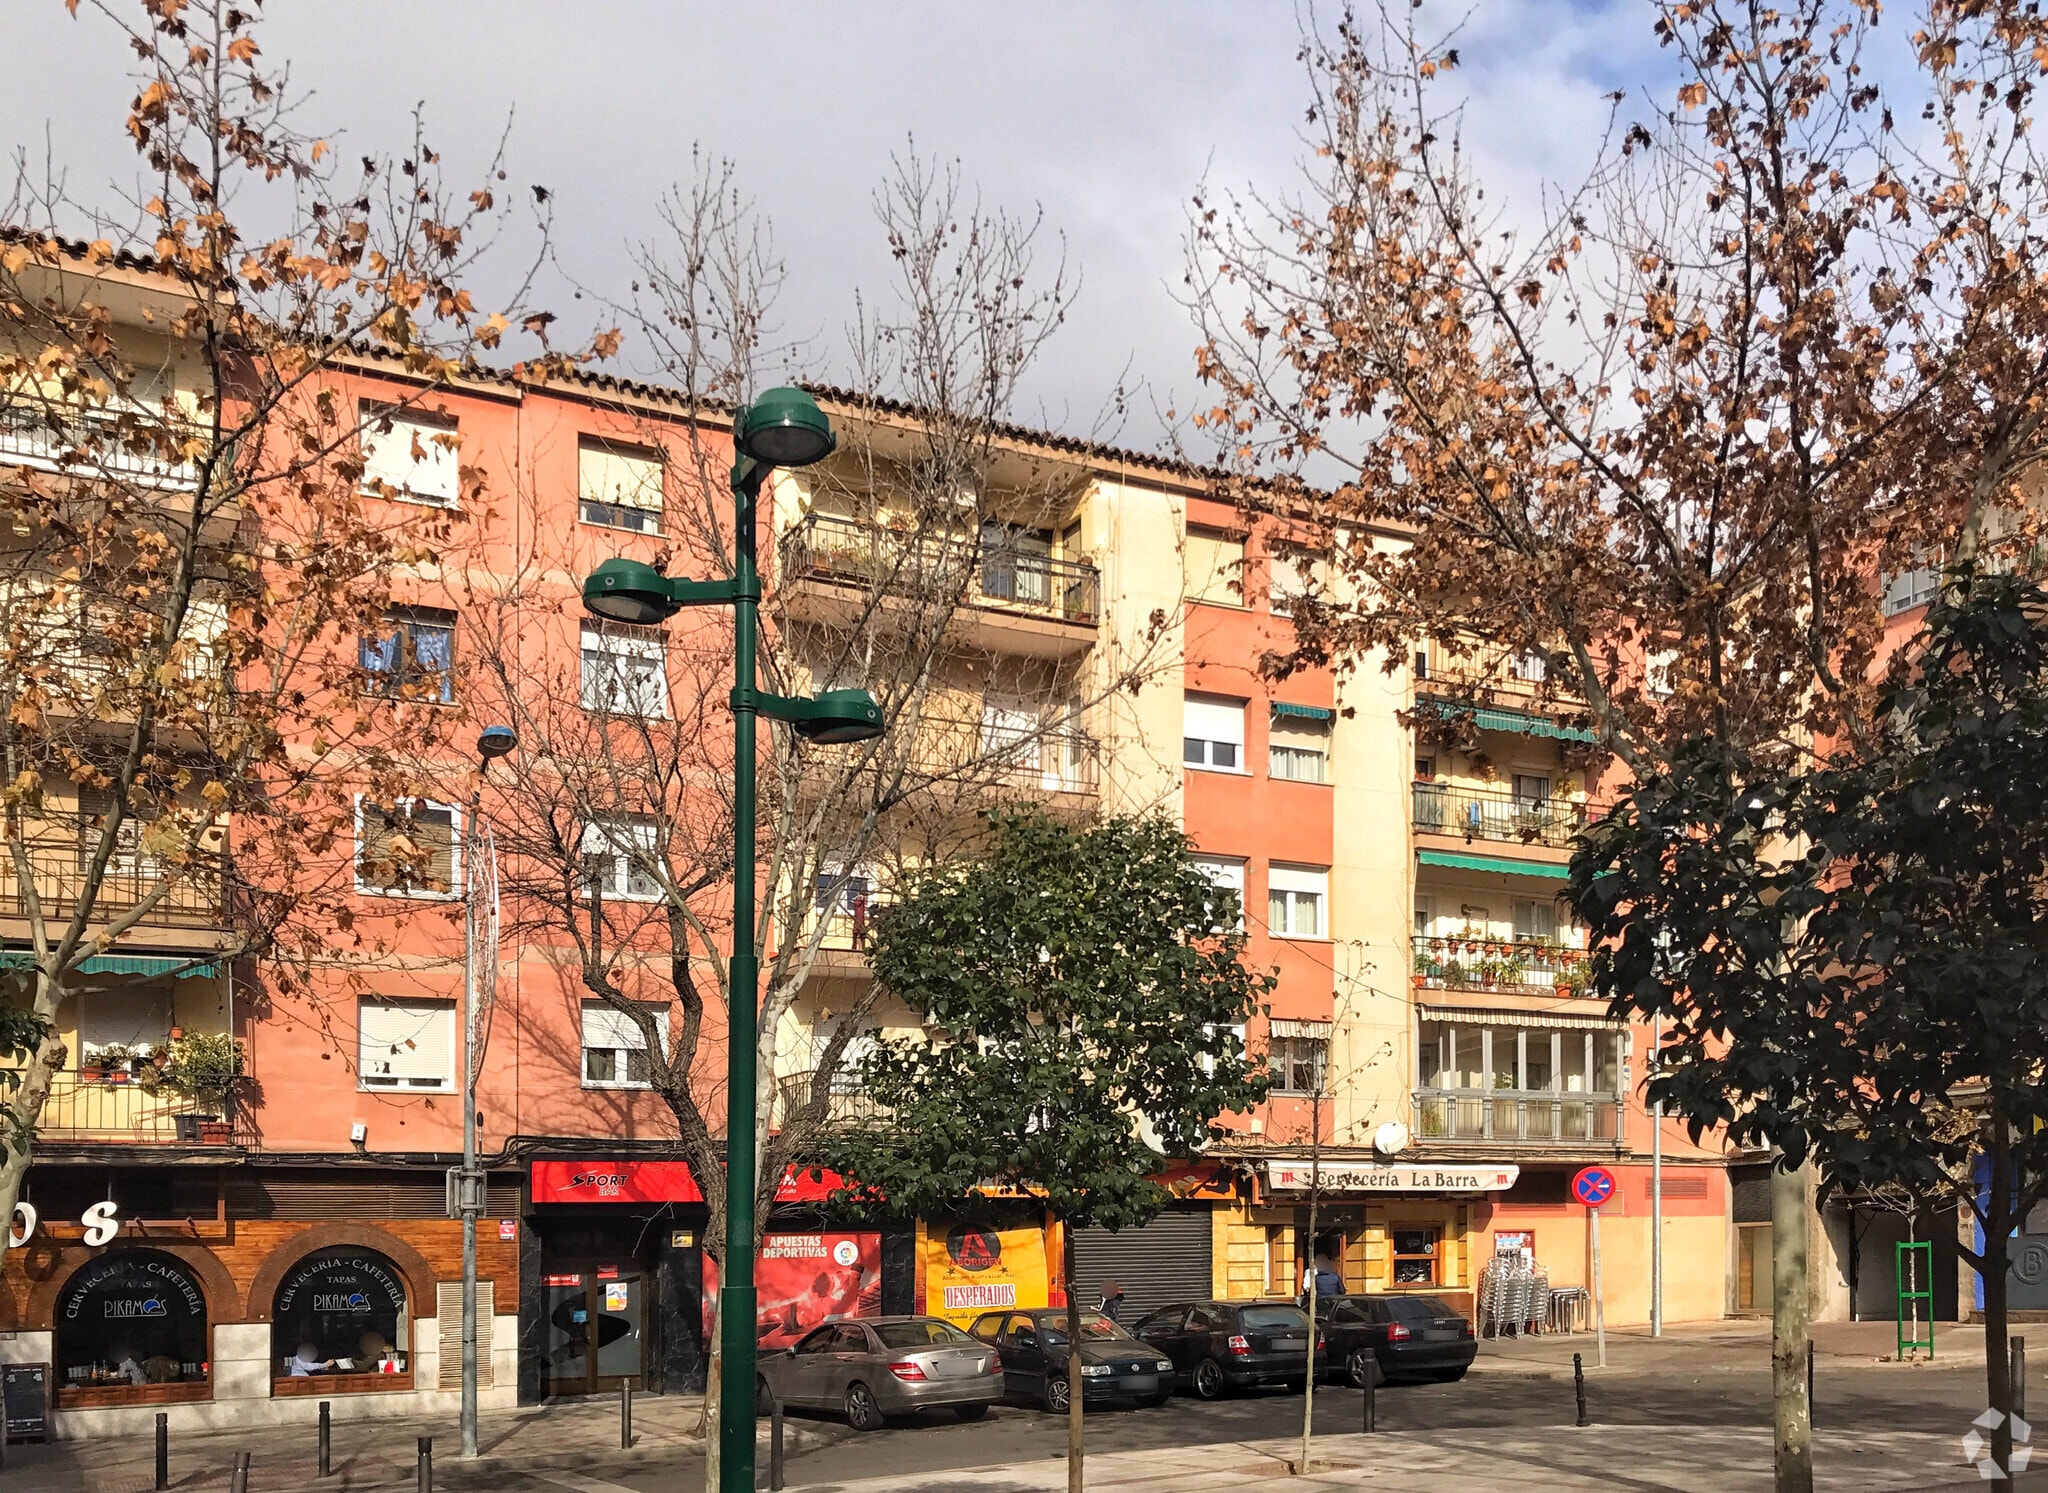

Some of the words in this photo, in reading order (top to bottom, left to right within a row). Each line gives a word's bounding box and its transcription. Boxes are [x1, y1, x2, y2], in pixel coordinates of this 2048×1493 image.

[562, 1172, 628, 1189] SPORT
[1411, 1172, 1431, 1187] La
[1435, 1172, 1479, 1187] Barra
[599, 1187, 620, 1197] BAR
[769, 1236, 822, 1248] APUESTAS
[763, 1246, 828, 1259] DEPORTIVAS
[949, 1257, 1002, 1267] ABORIGEN
[327, 1276, 357, 1284] TAPAS
[945, 1285, 1015, 1308] DESPERADOS
